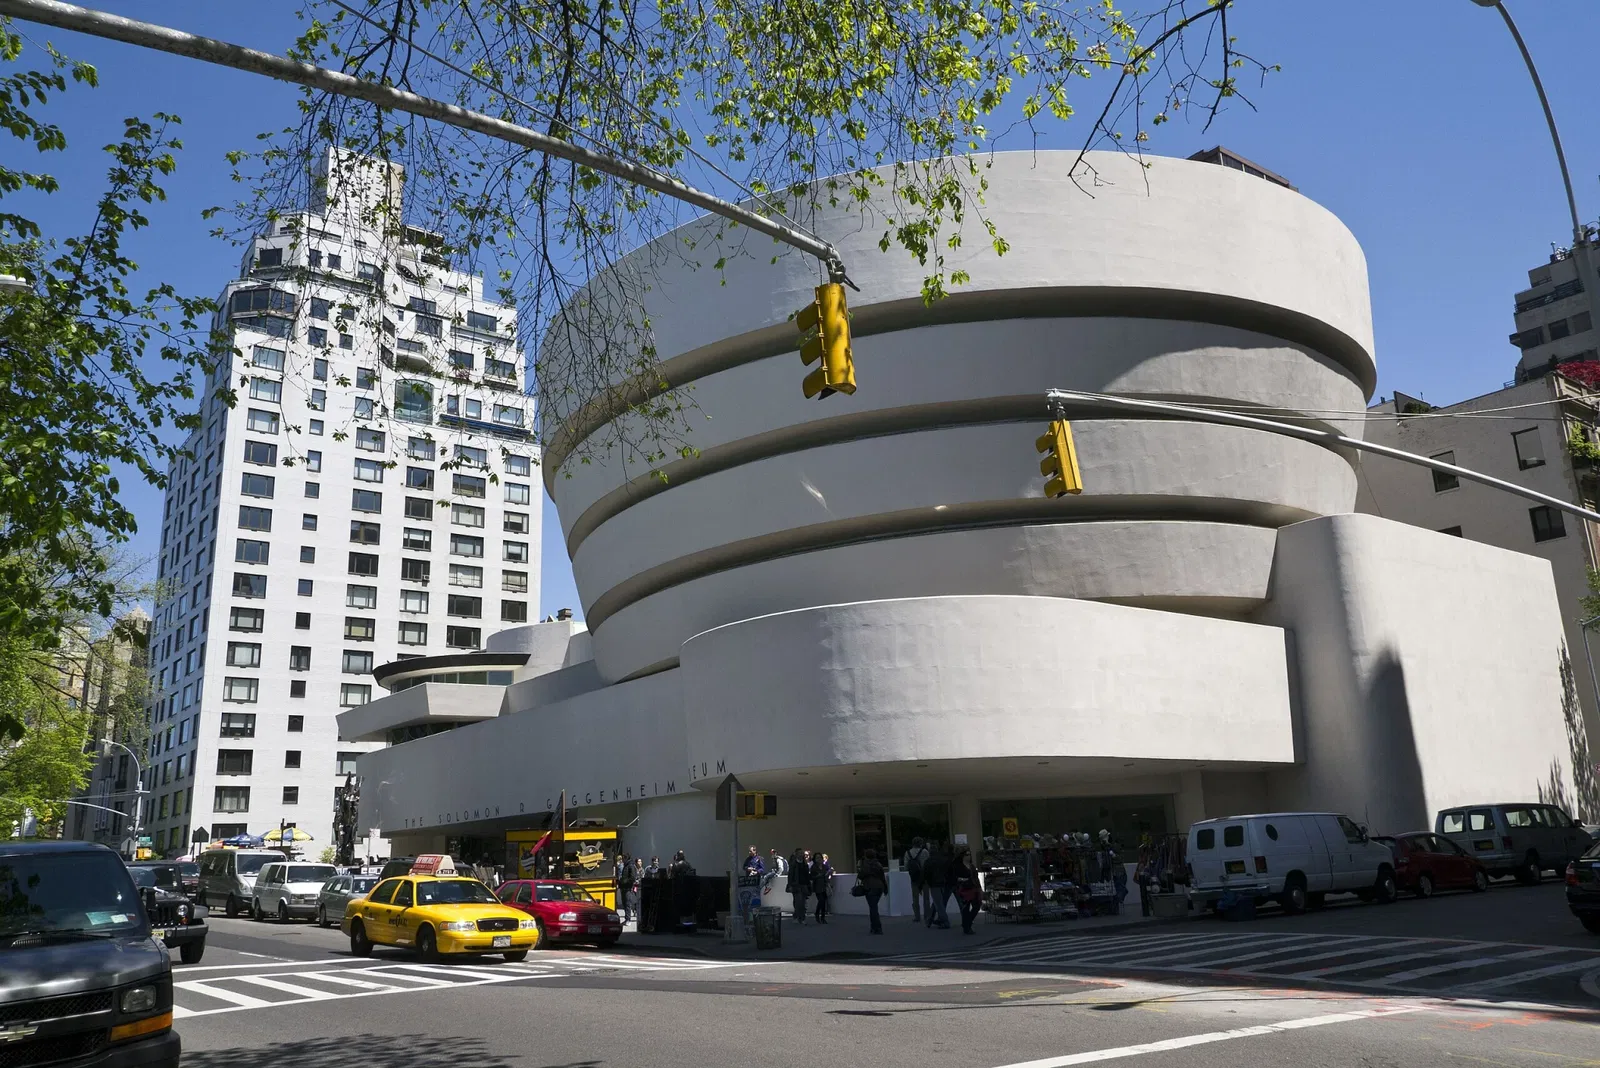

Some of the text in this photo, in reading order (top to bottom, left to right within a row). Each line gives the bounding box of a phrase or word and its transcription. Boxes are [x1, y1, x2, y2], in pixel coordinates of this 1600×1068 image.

[404, 817, 423, 829] THE
[438, 805, 500, 824] SOLOMON
[546, 780, 676, 810] GGGENHEIM
[688, 759, 727, 782] EUM
